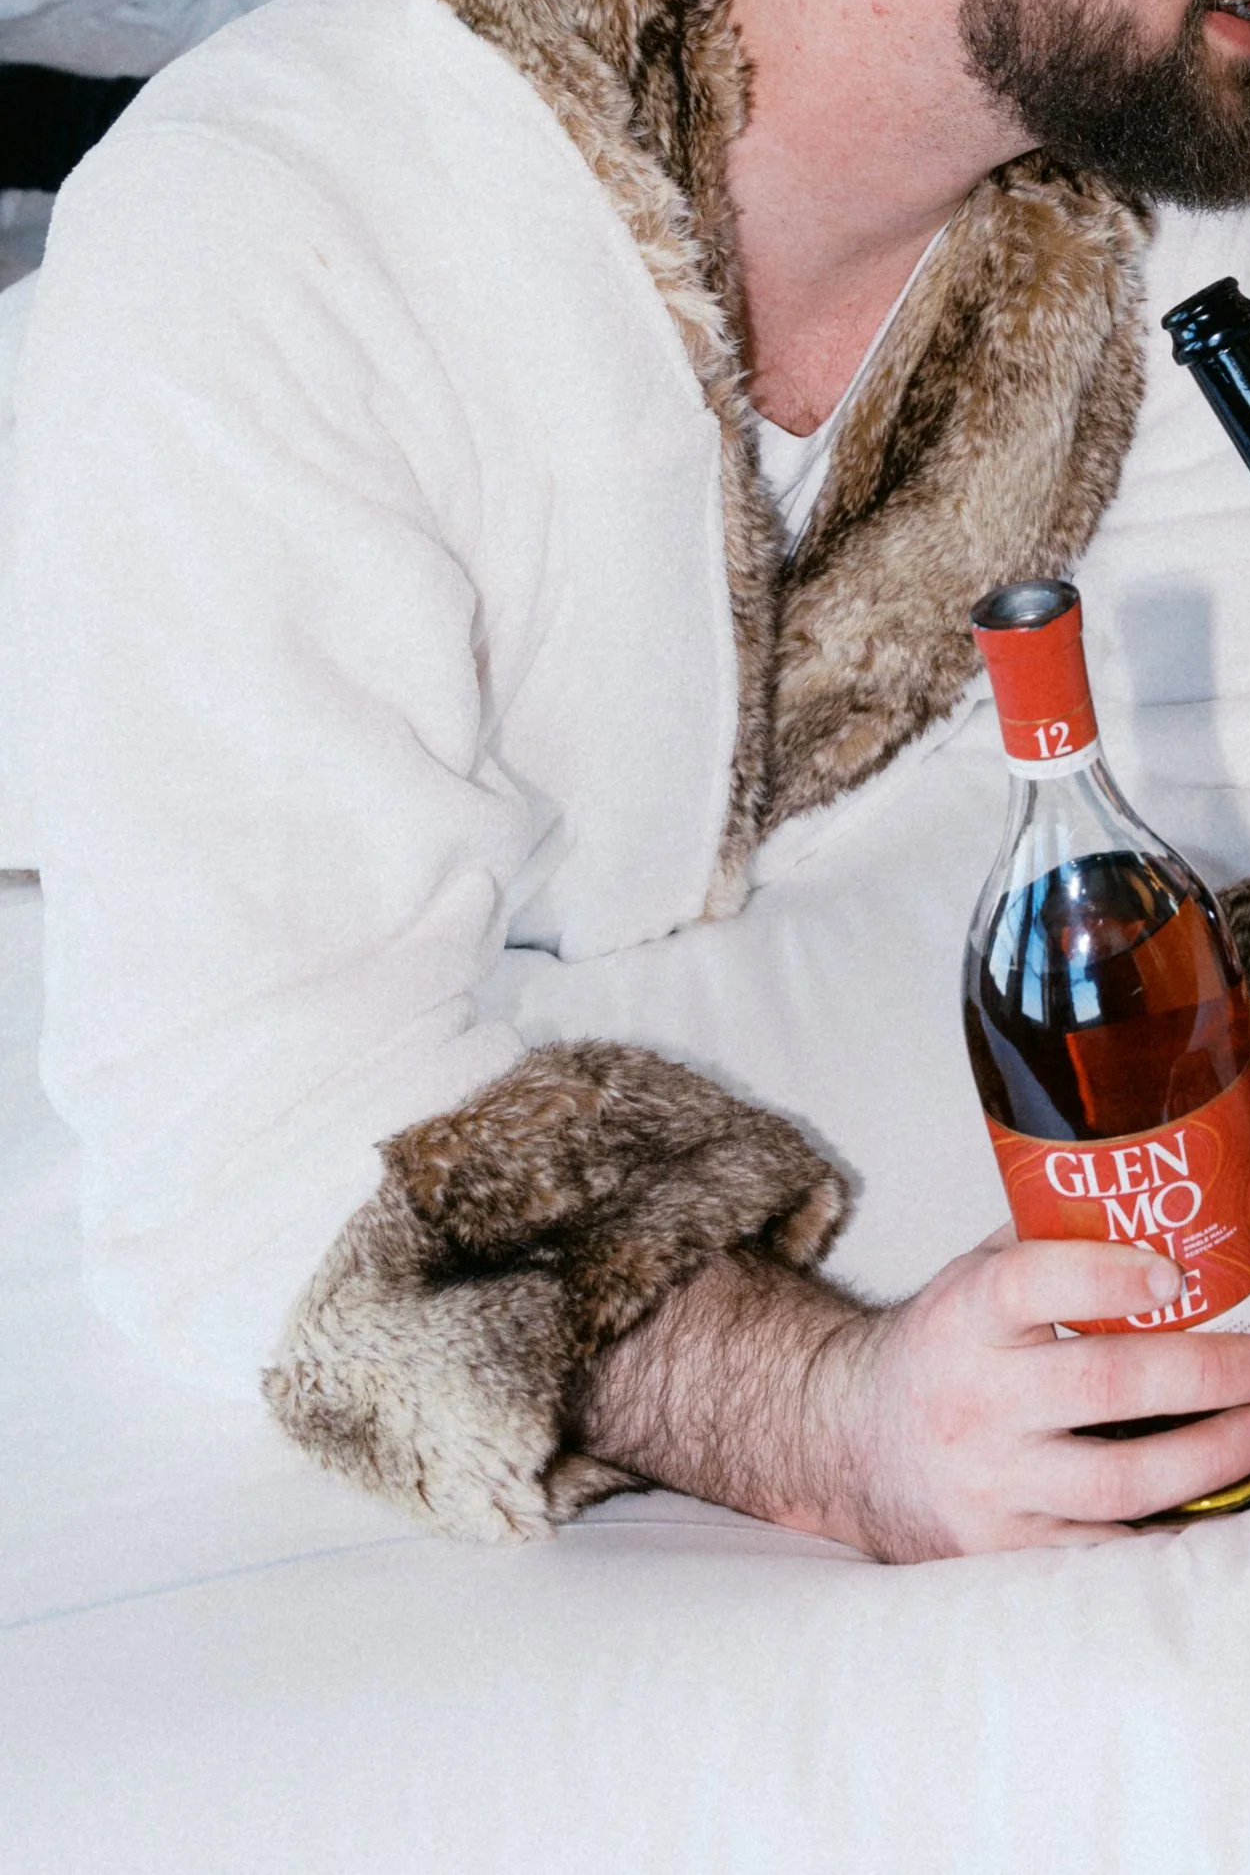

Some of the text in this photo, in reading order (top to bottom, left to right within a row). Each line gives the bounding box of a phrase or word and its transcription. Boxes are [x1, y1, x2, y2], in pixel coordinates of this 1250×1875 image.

[1033, 721, 1074, 759] 12
[1045, 1130, 1189, 1198] GLEN
[1102, 1180, 1202, 1241] MO
